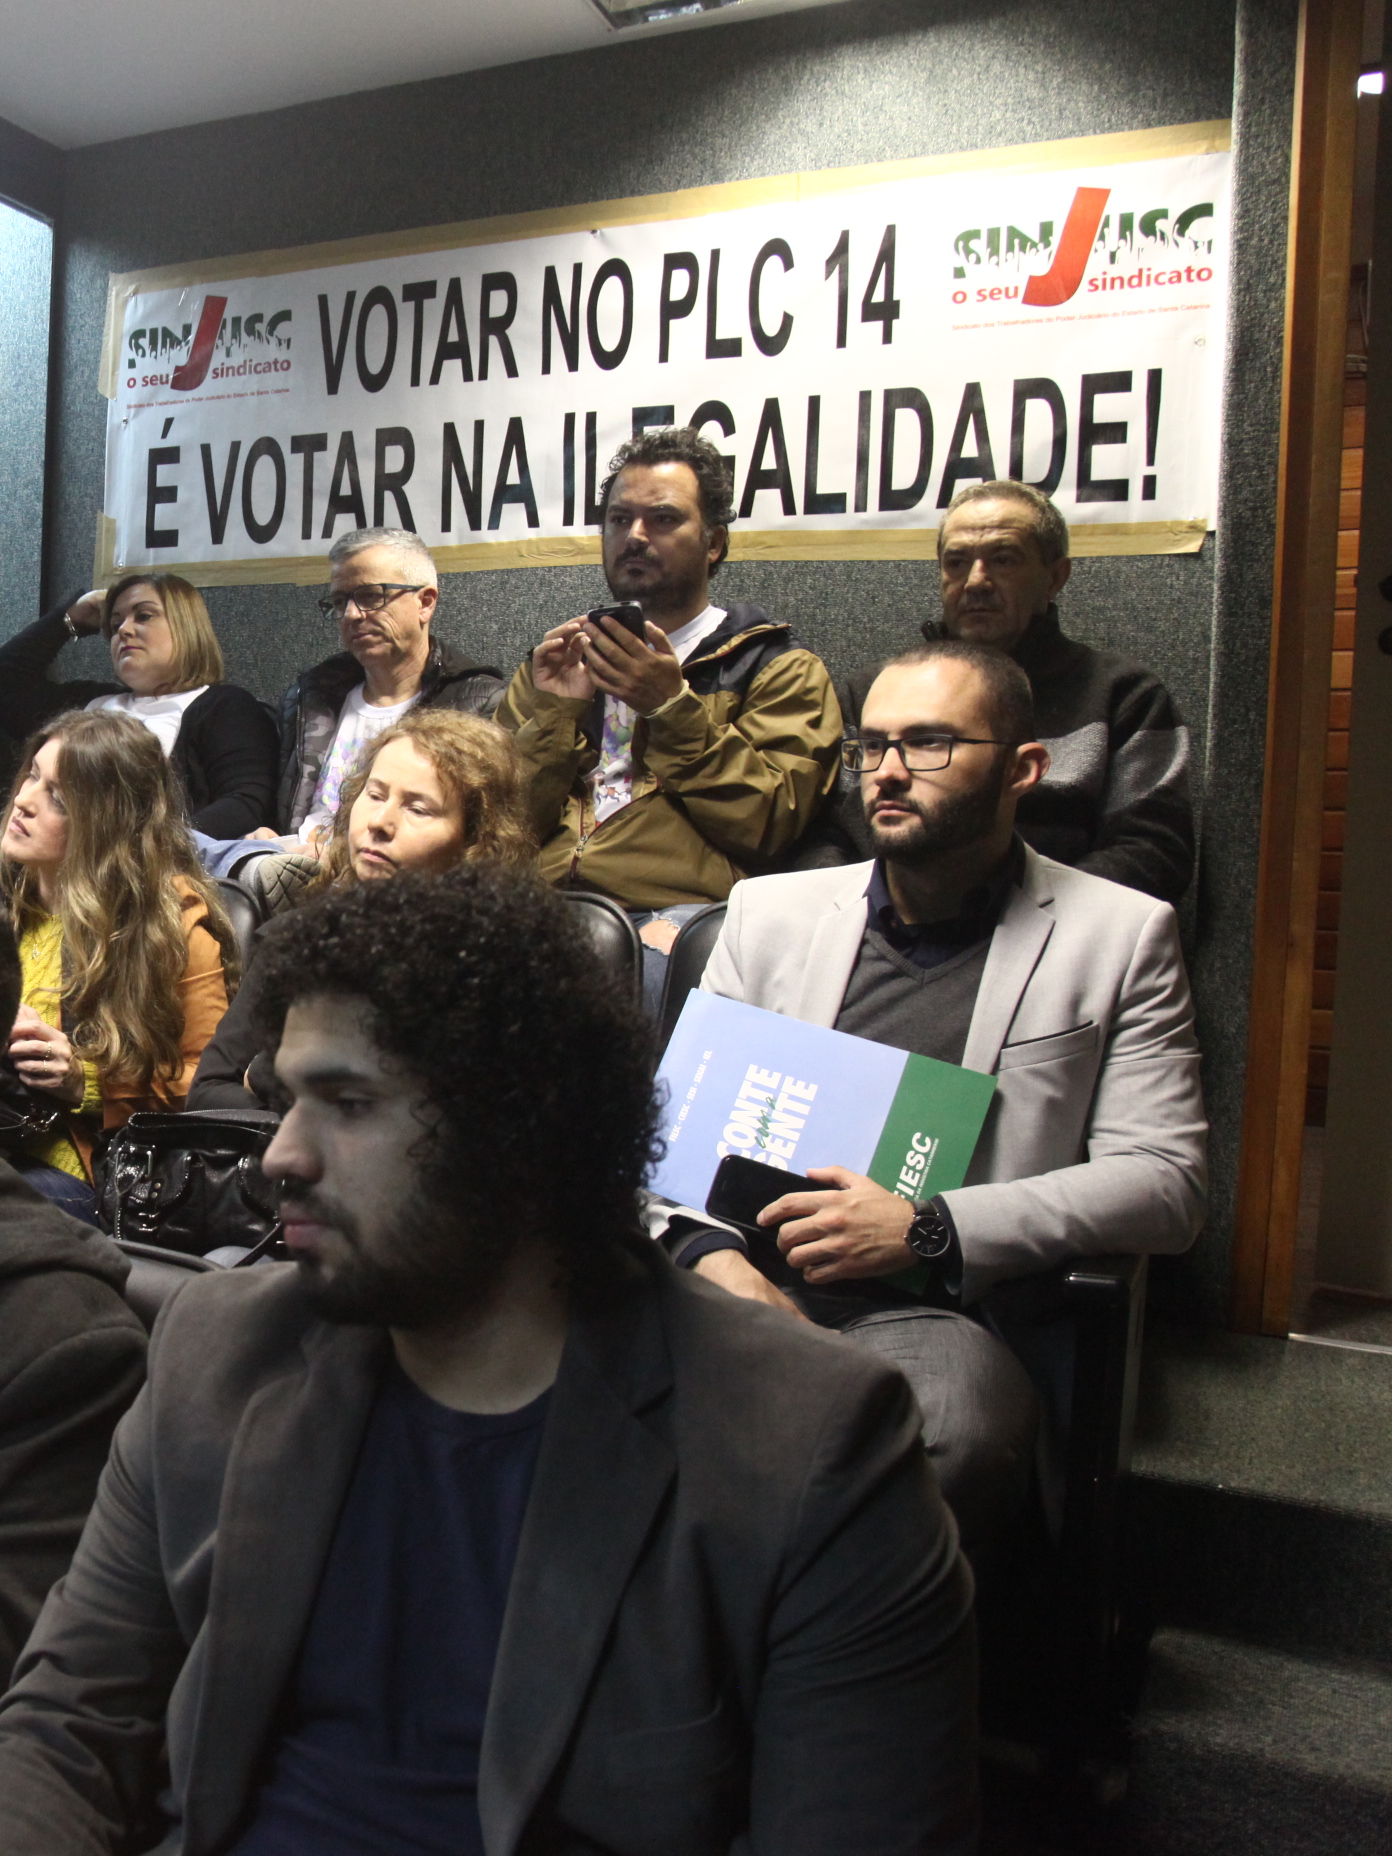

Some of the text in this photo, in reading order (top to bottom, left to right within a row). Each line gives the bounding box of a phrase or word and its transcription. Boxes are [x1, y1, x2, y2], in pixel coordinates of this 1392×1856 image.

[317, 223, 901, 396] VOTAR NO PLC 14
[951, 265, 1213, 304] o seu sindicato
[126, 358, 292, 389] o seu sindicato
[144, 367, 1163, 550] É VOTAR NA ILALIDADE!
[716, 1063, 782, 1159] CONTE
[753, 1075, 819, 1172] GENTE
[893, 1132, 932, 1200] IESC
